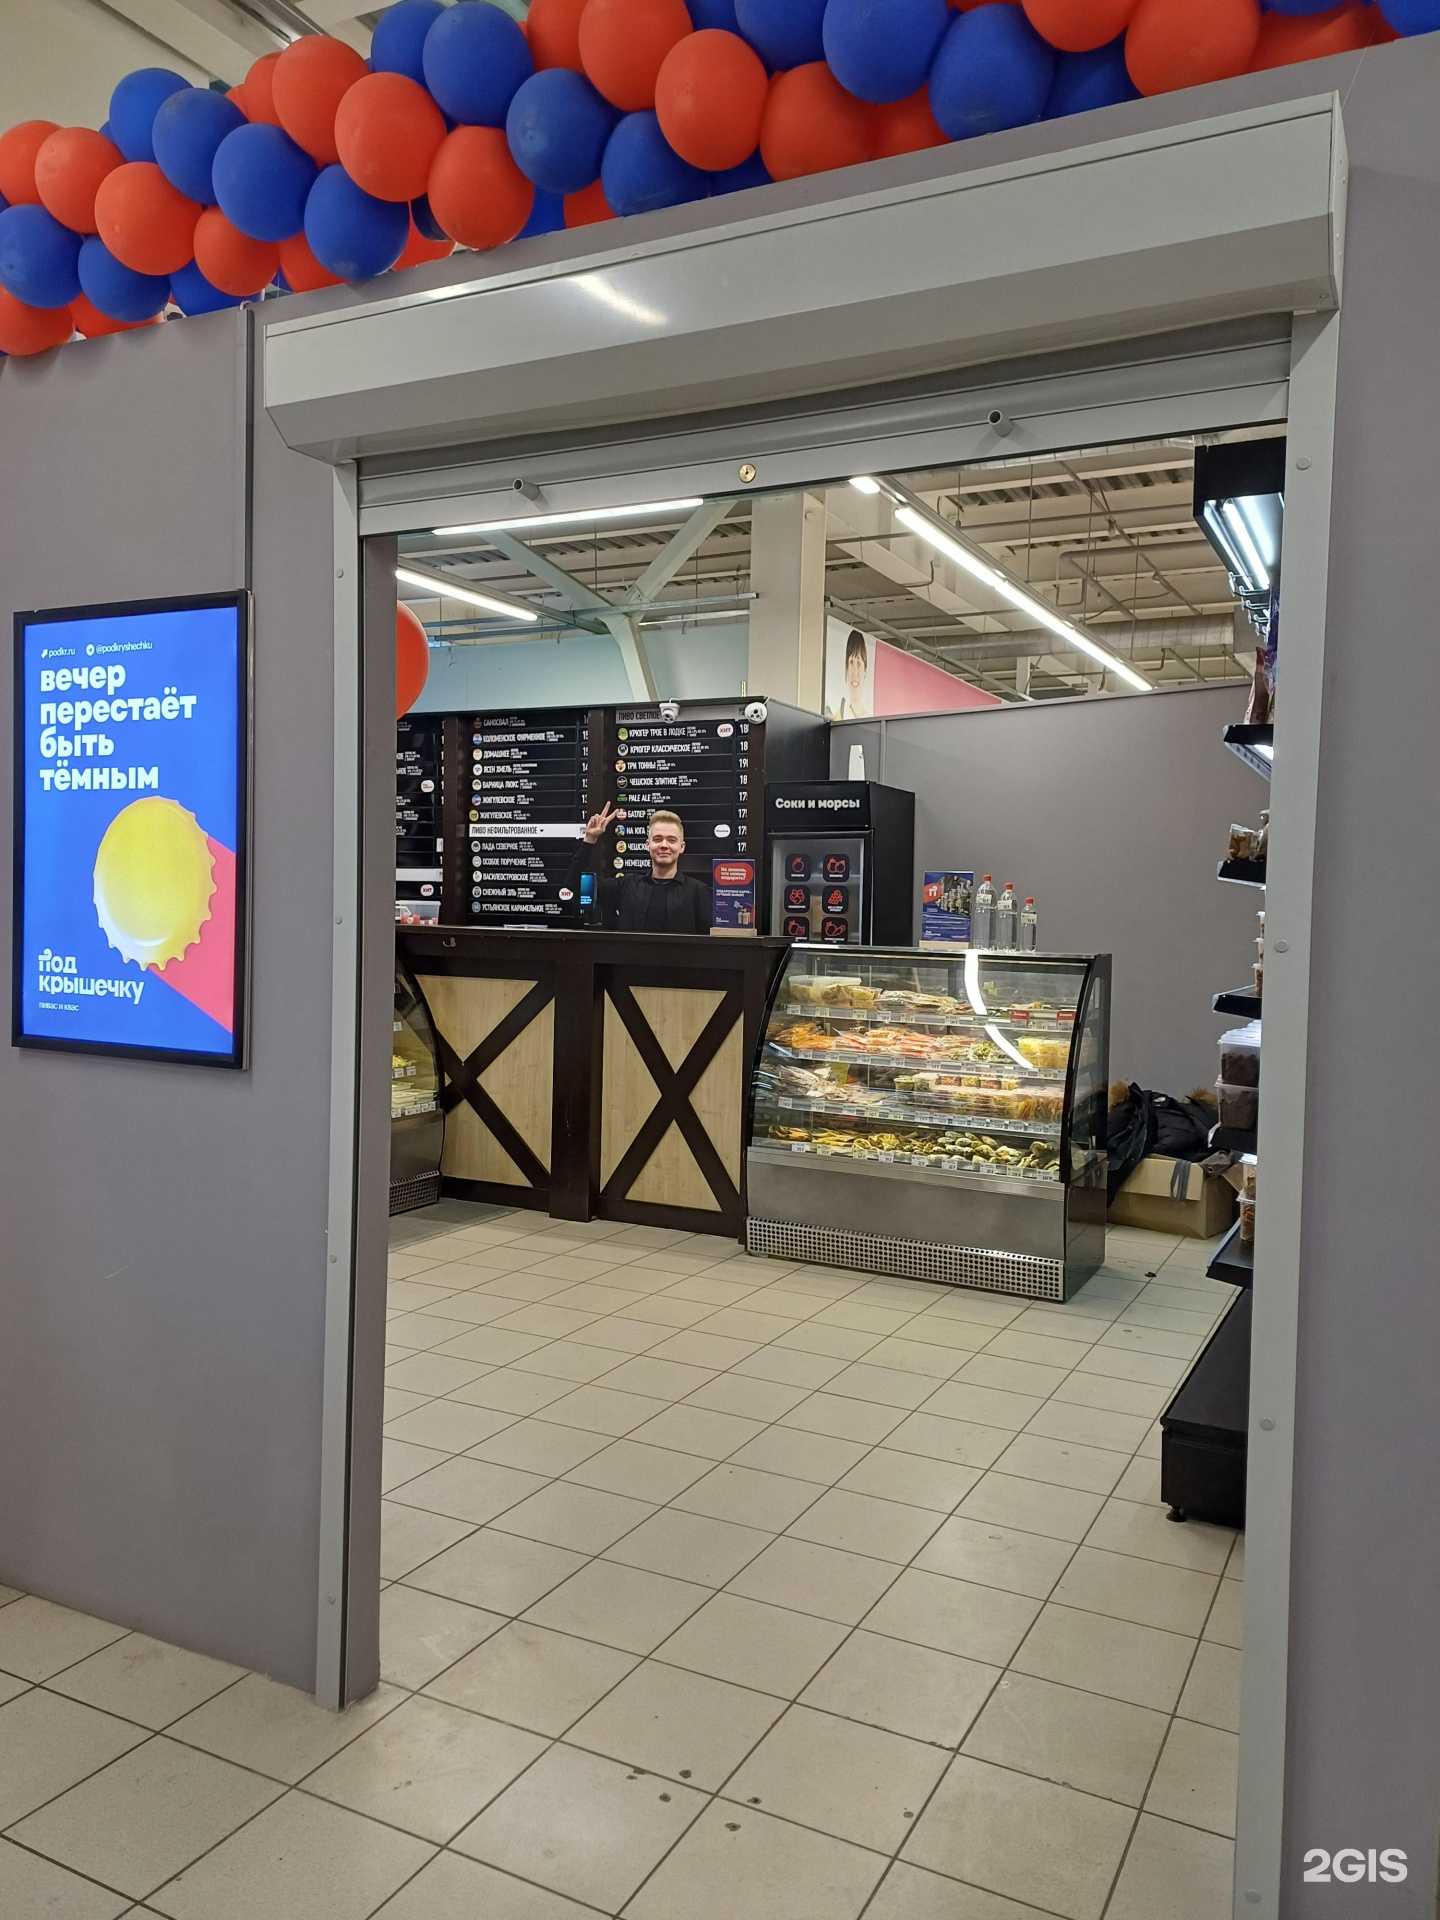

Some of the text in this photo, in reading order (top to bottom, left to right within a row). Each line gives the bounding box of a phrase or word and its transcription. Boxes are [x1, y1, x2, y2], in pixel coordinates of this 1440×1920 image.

[48, 647, 76, 658] podkr.ru
[40, 664, 126, 695] вечер
[40, 686, 197, 730] перестаёт
[618, 712, 634, 721] ПИВО
[650, 728, 662, 737] ТРОЕ
[663, 727, 668, 737] В
[39, 726, 115, 758] быть
[39, 759, 159, 791] тёмным
[628, 794, 641, 804] PALE
[641, 793, 651, 803] ALE
[775, 798, 860, 811] Соки и морсы
[471, 826, 538, 835] ПИВО НЕФИЛЬТРОВАННОЕ
[624, 858, 651, 868] НЕМЕЦКОЕ
[38, 948, 78, 974] Под
[38, 975, 144, 1005] крышечку
